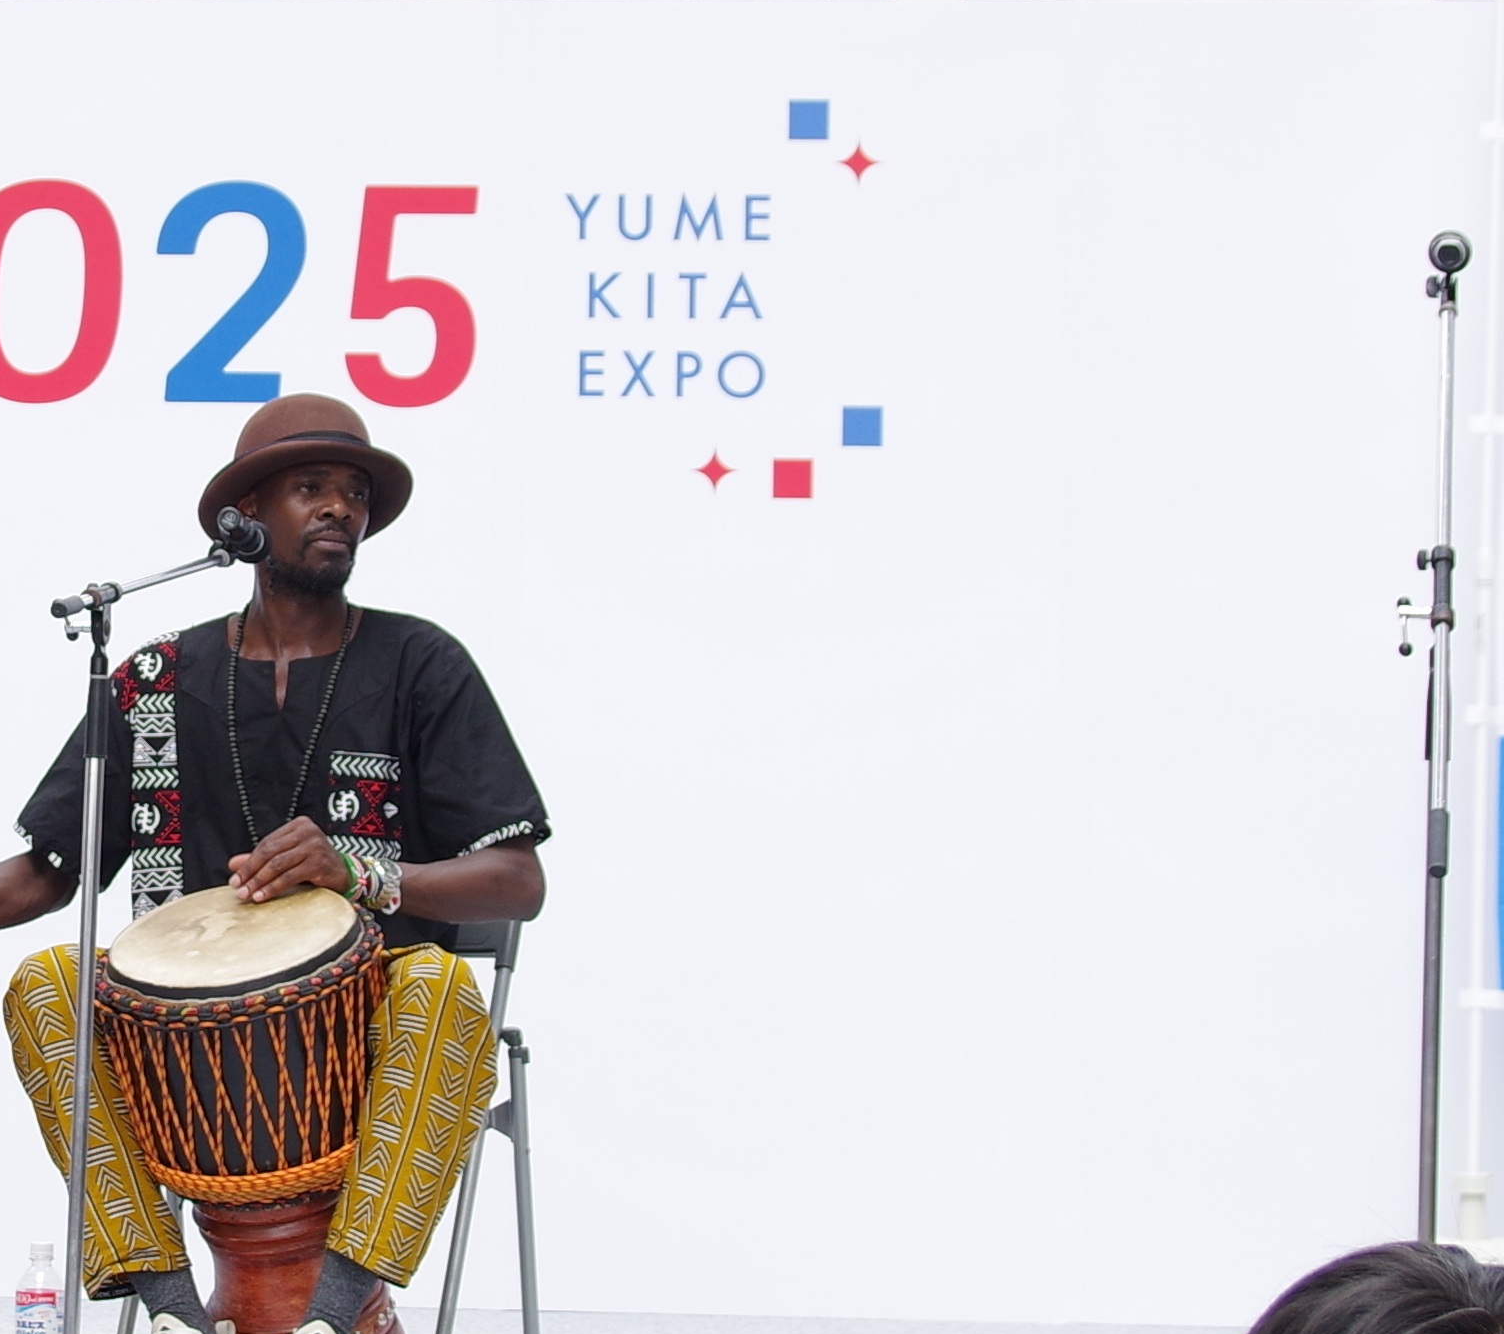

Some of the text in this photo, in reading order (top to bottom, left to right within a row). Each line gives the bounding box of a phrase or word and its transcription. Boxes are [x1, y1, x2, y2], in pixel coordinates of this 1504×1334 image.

[565, 193, 774, 243] YUME
[587, 271, 764, 321] KITA
[578, 350, 768, 400] EXPO
